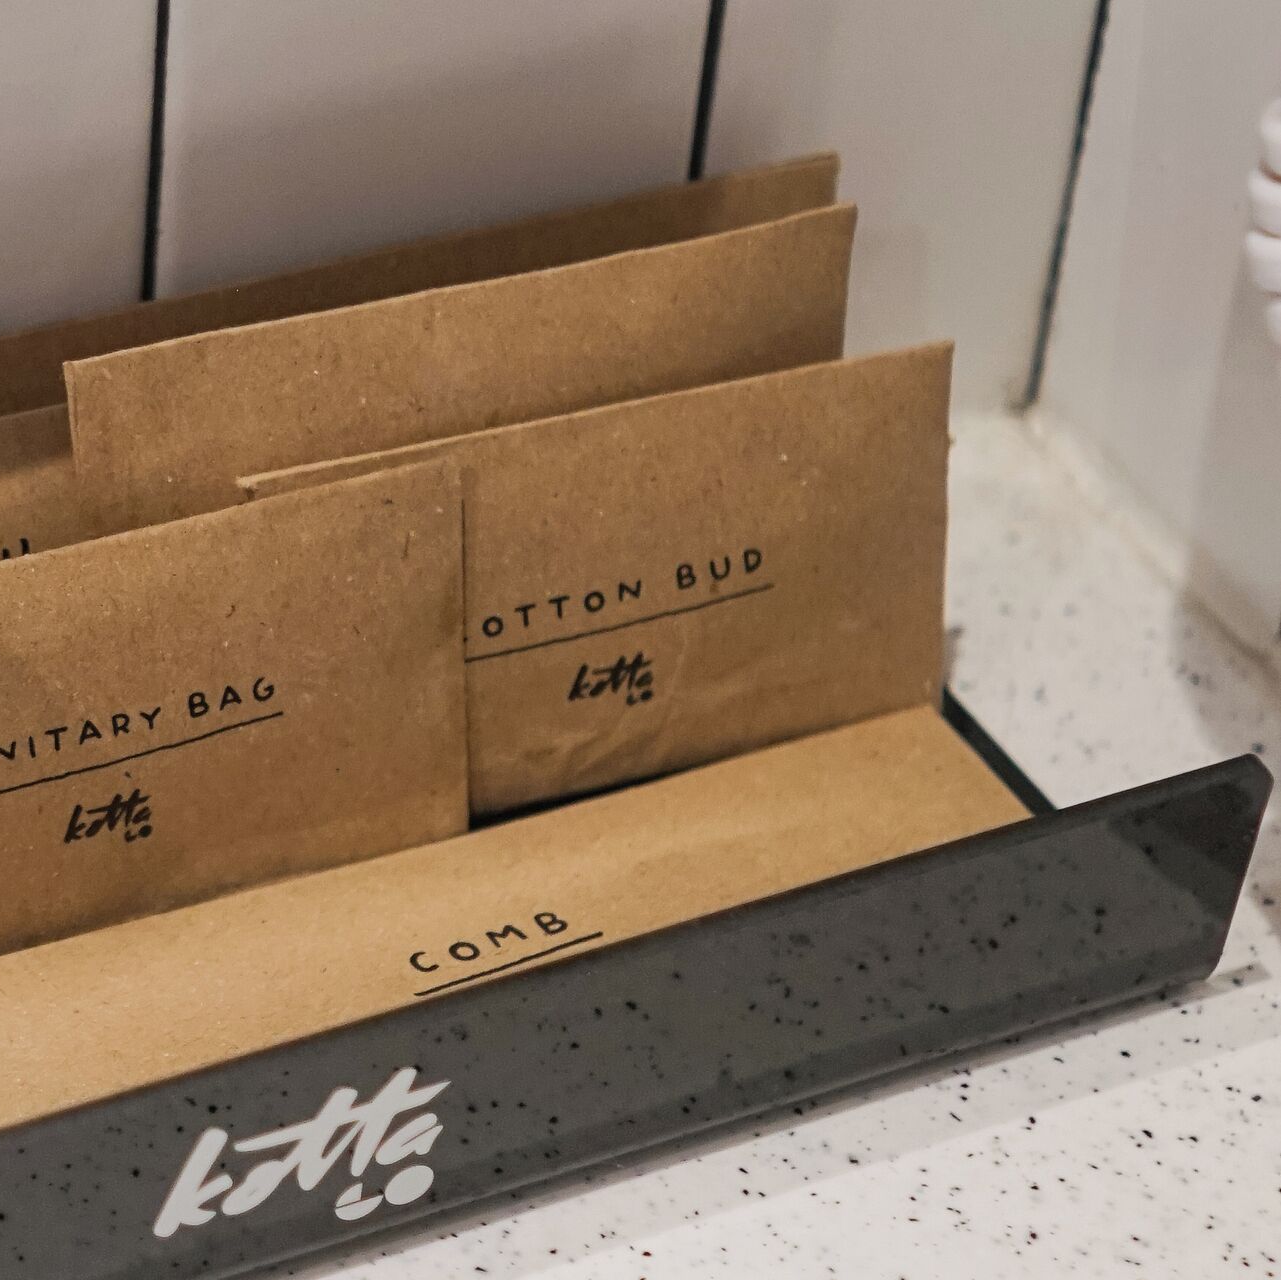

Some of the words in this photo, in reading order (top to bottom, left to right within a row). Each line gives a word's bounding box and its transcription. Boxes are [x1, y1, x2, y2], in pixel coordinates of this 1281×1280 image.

[463, 579, 642, 643] OTTON
[676, 547, 763, 590] BUD
[187, 675, 277, 718] BAG
[409, 910, 569, 974] COMB
